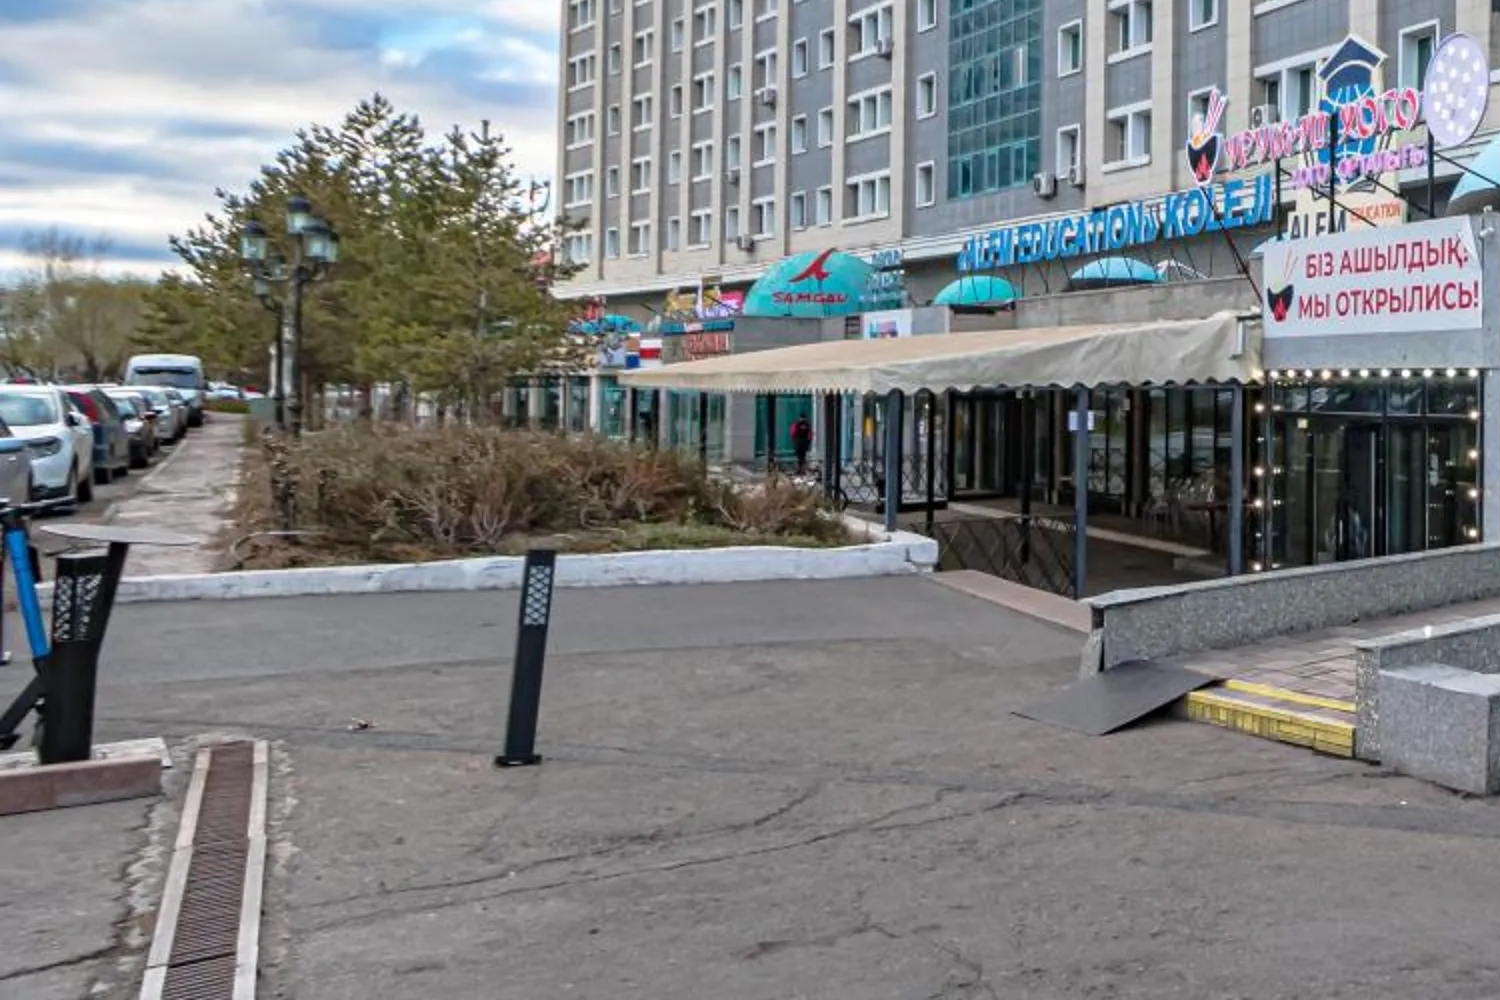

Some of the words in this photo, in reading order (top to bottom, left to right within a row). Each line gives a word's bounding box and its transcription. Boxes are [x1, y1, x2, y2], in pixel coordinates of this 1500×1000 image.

[1163, 172, 1274, 241] KOLEJI
[1306, 251, 1333, 279] БІЗ
[1298, 292, 1330, 320] МЫ
[1335, 279, 1480, 317] ОТКРЫЛИСЬ!
